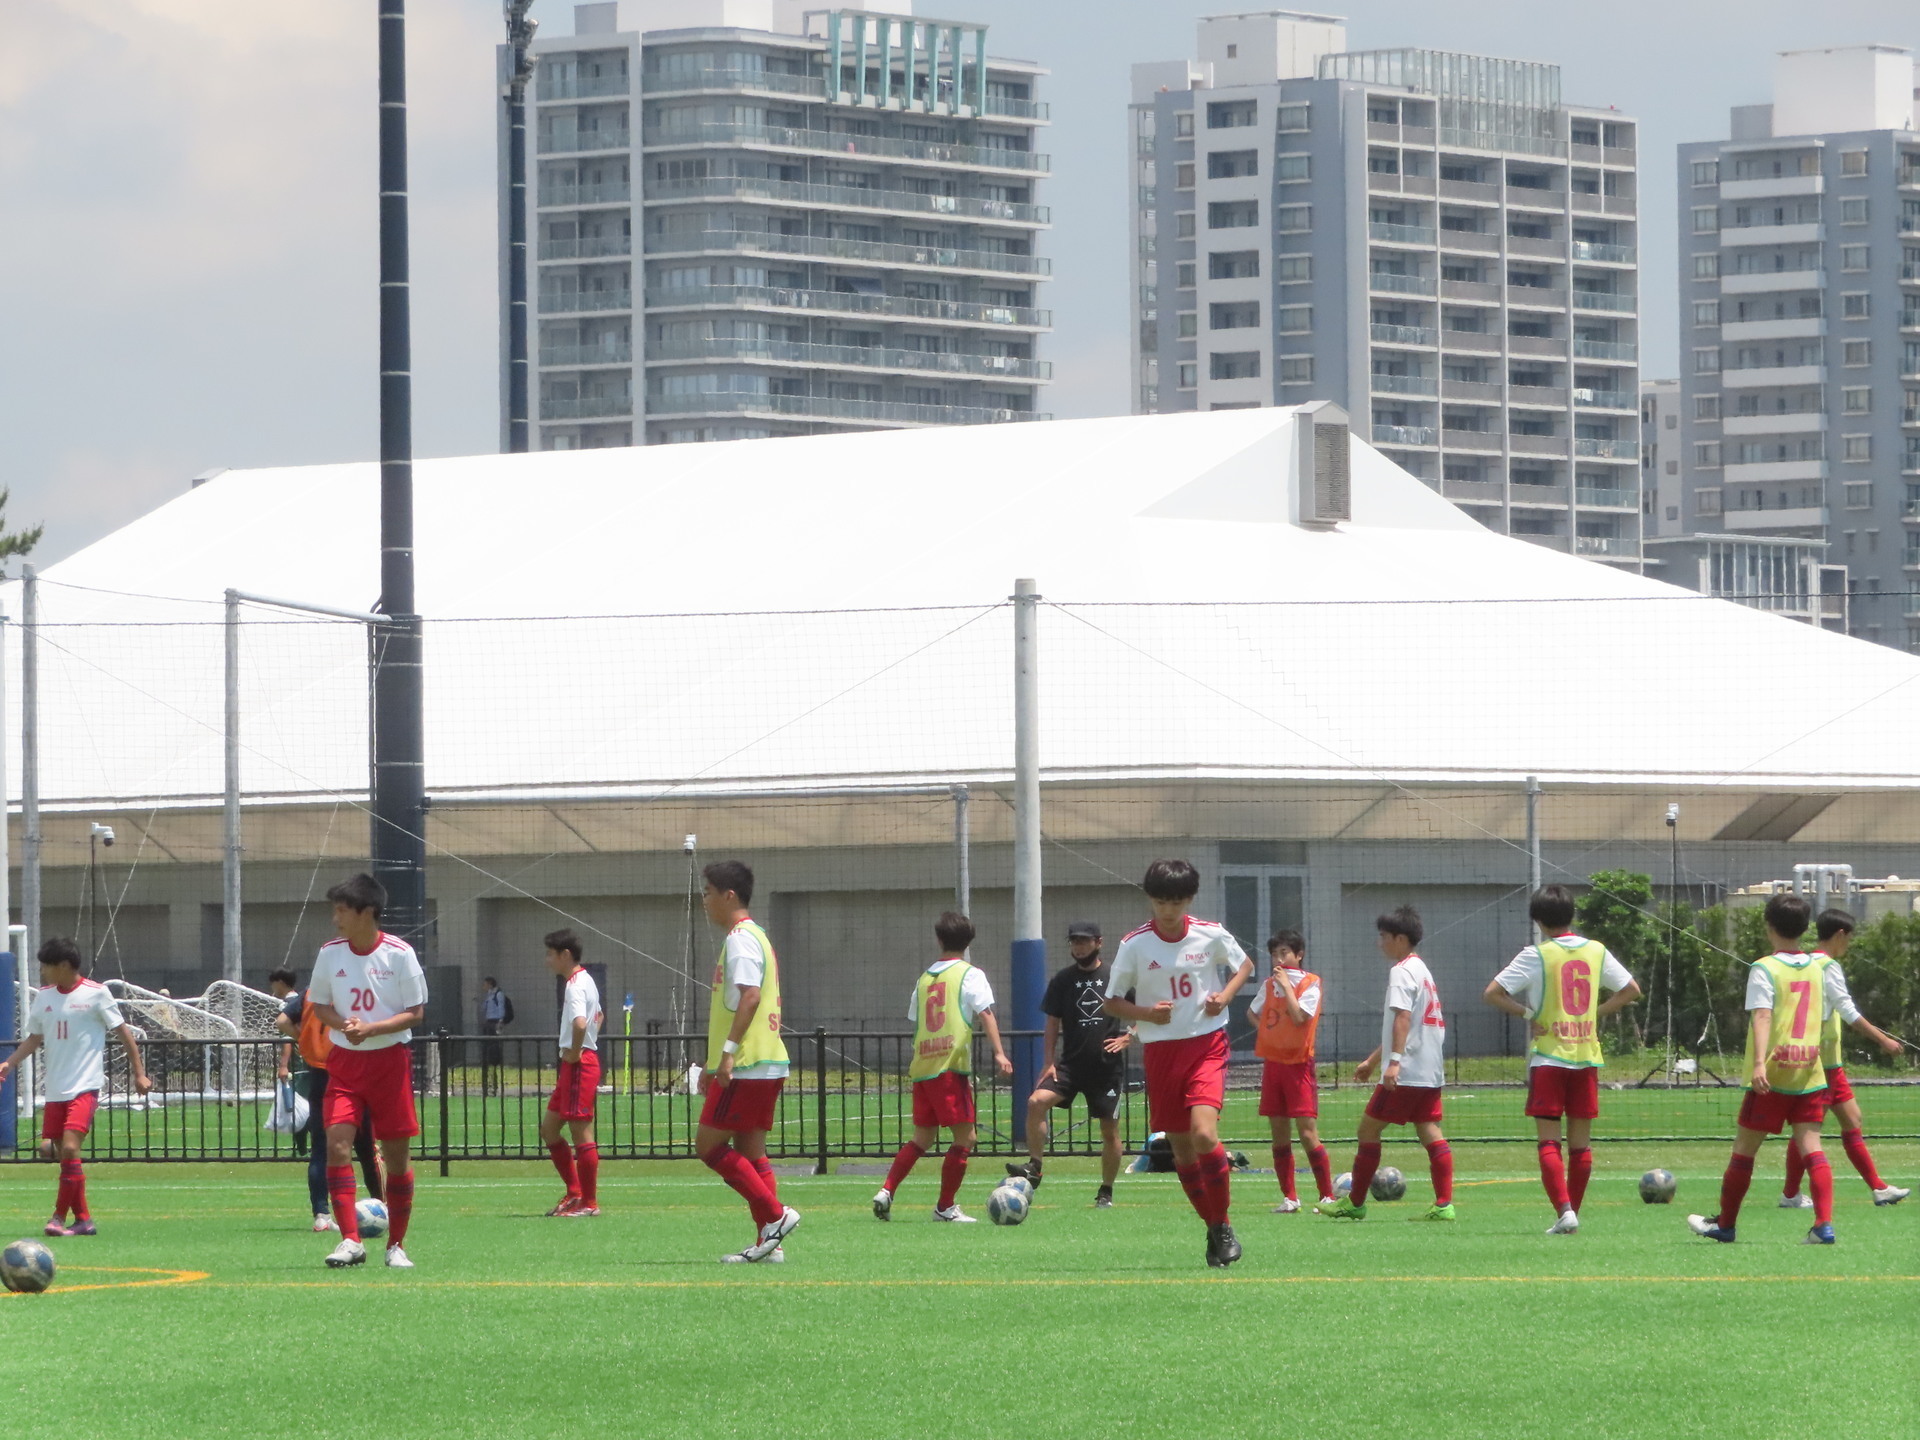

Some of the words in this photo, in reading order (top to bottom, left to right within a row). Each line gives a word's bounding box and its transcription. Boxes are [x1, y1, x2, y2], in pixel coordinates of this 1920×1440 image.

[350, 987, 375, 1011] 20
[1170, 973, 1192, 1000] 16
[1561, 960, 1590, 1015] 6
[1790, 981, 1810, 1039] 7
[57, 1020, 68, 1040] 11
